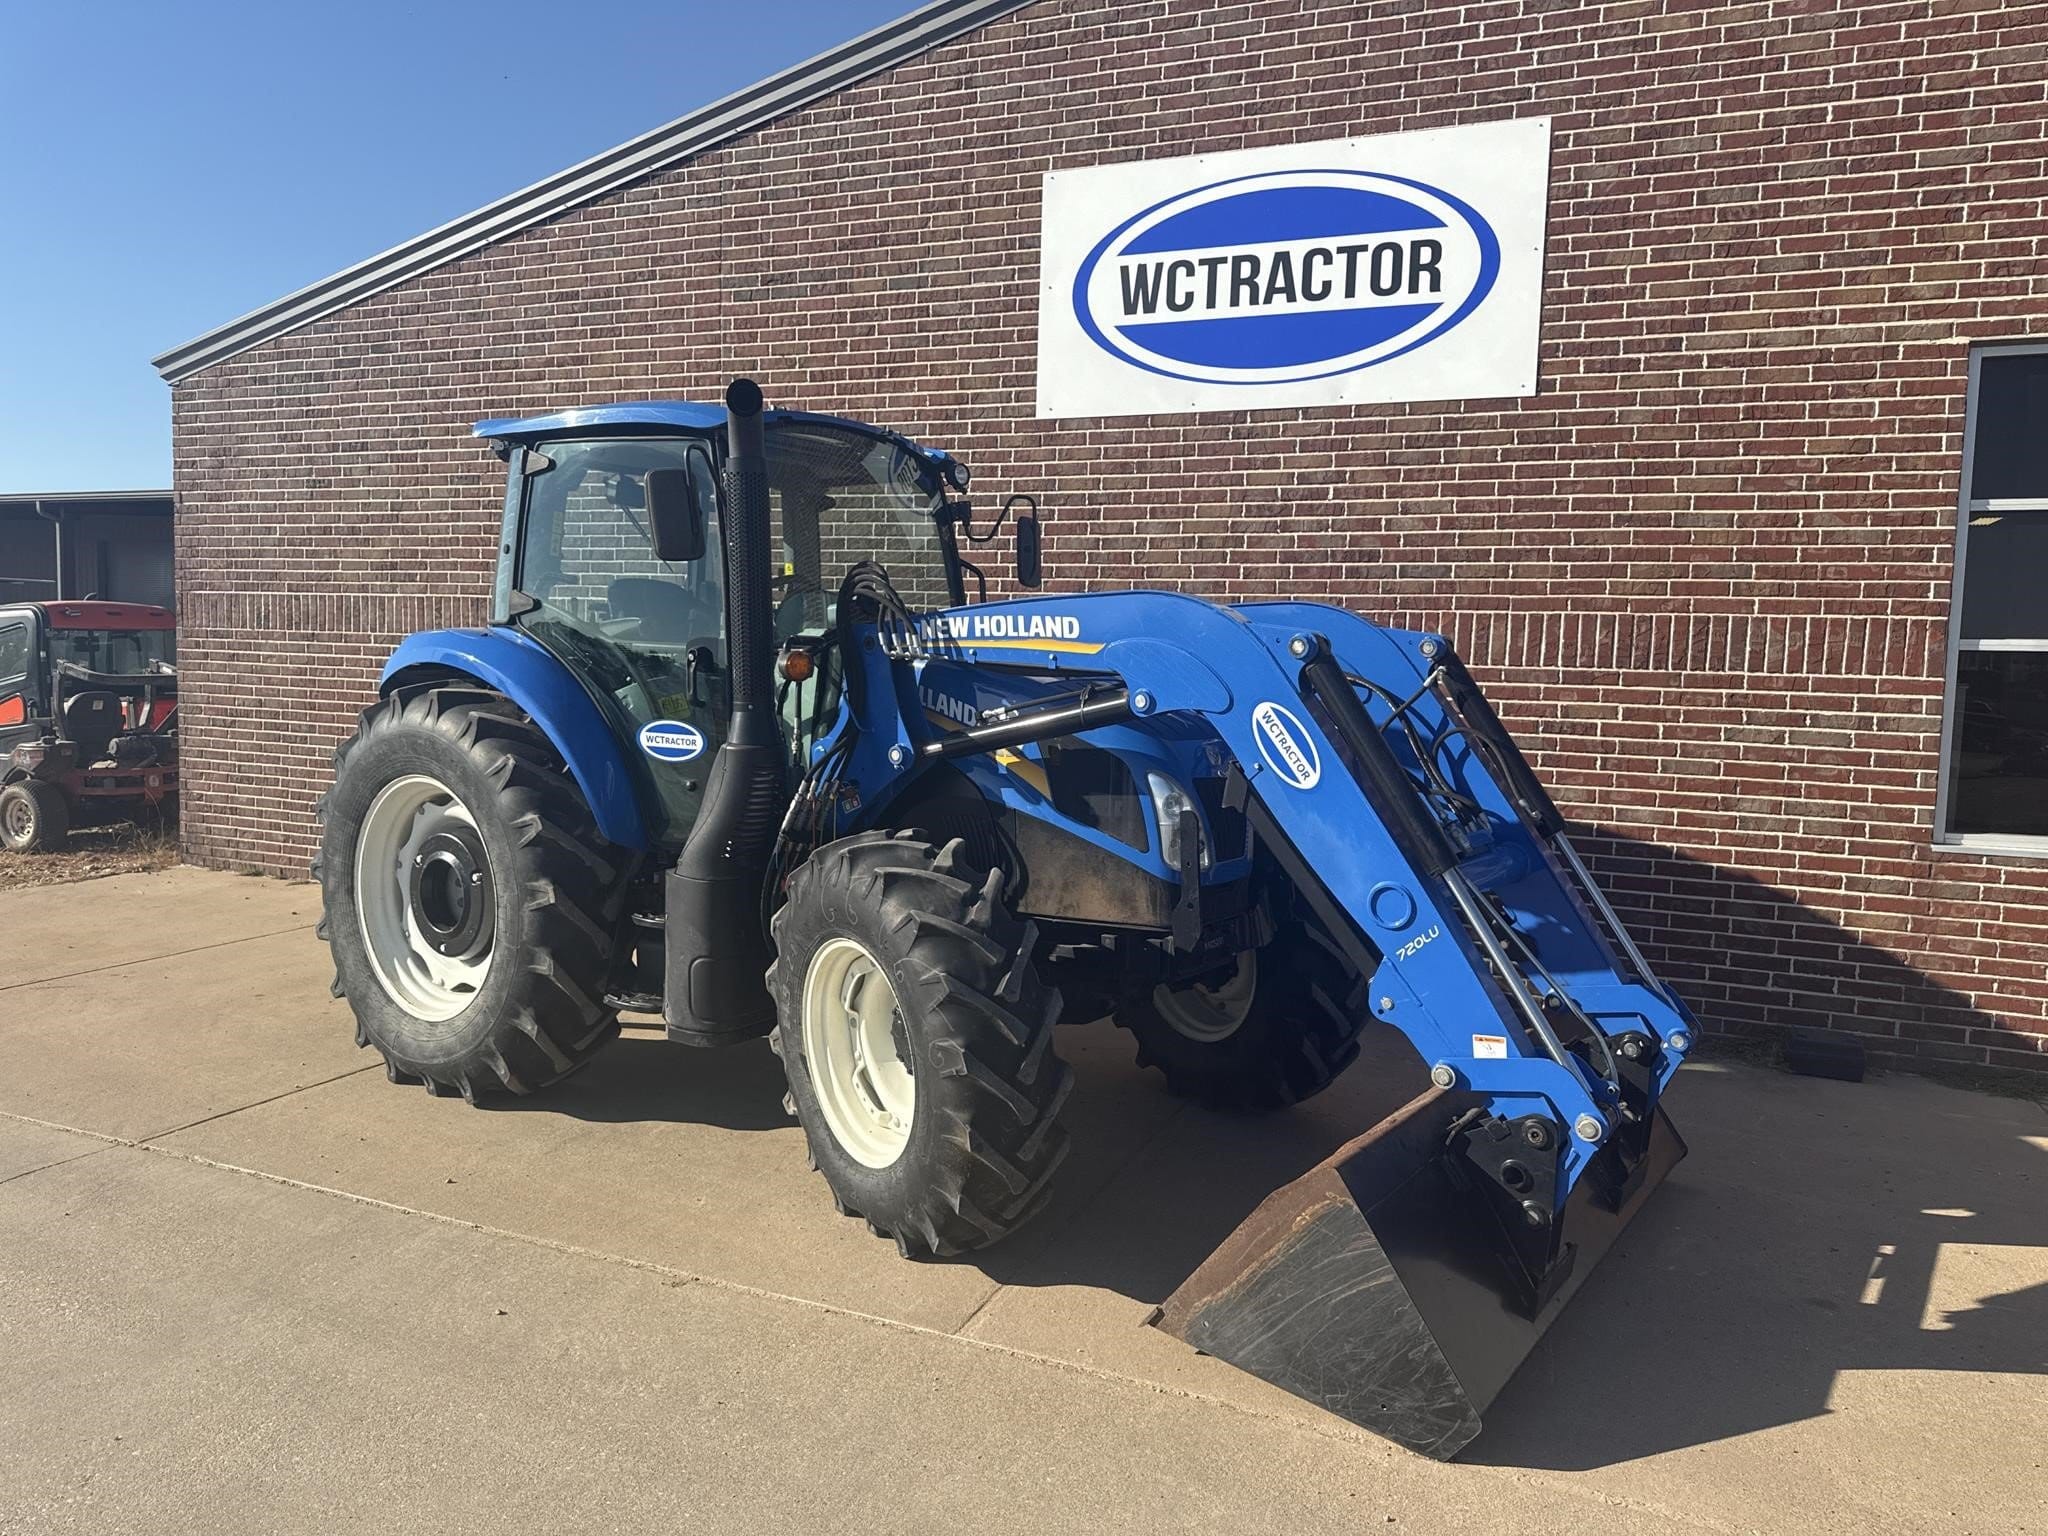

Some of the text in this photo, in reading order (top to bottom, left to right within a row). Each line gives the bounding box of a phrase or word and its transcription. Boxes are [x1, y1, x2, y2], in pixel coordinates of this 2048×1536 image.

[1119, 239, 1443, 316] WCTRACTOR
[920, 615, 1080, 640] NEW HOLLAND
[918, 686, 977, 727] LLAND
[645, 735, 697, 747] WCTRACTOR
[1261, 710, 1311, 781] WCTRACTOR
[1395, 924, 1440, 962] 720LU
